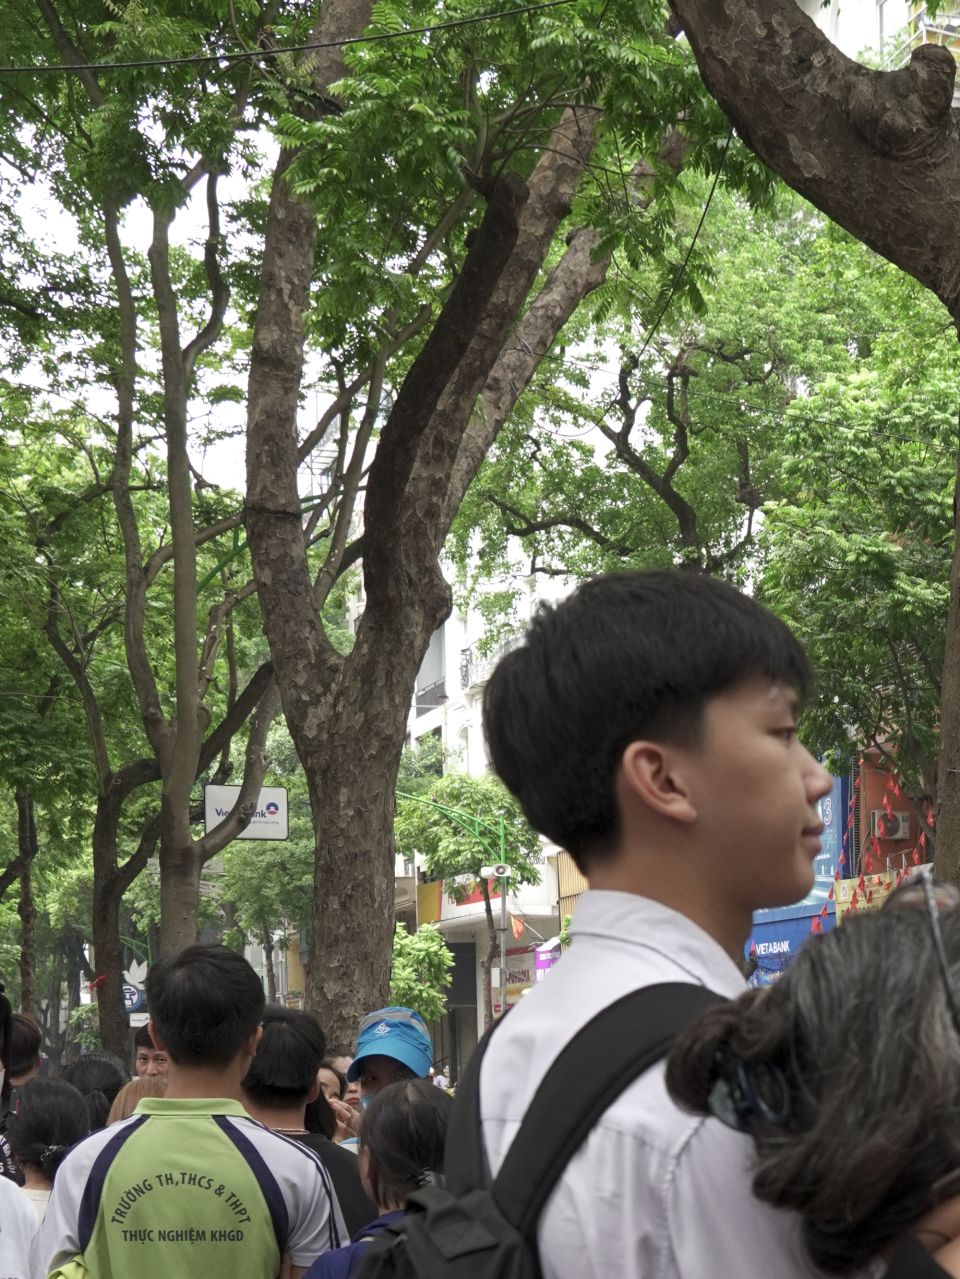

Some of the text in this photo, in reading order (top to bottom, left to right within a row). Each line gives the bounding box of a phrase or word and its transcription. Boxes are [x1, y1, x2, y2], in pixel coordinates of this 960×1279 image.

[111, 1179, 154, 1225] TRƯỜNG
[214, 1184, 226, 1198] &
[225, 1191, 251, 1225] THPT
[122, 1228, 244, 1245] THỰC NGHIỆM KHGD
